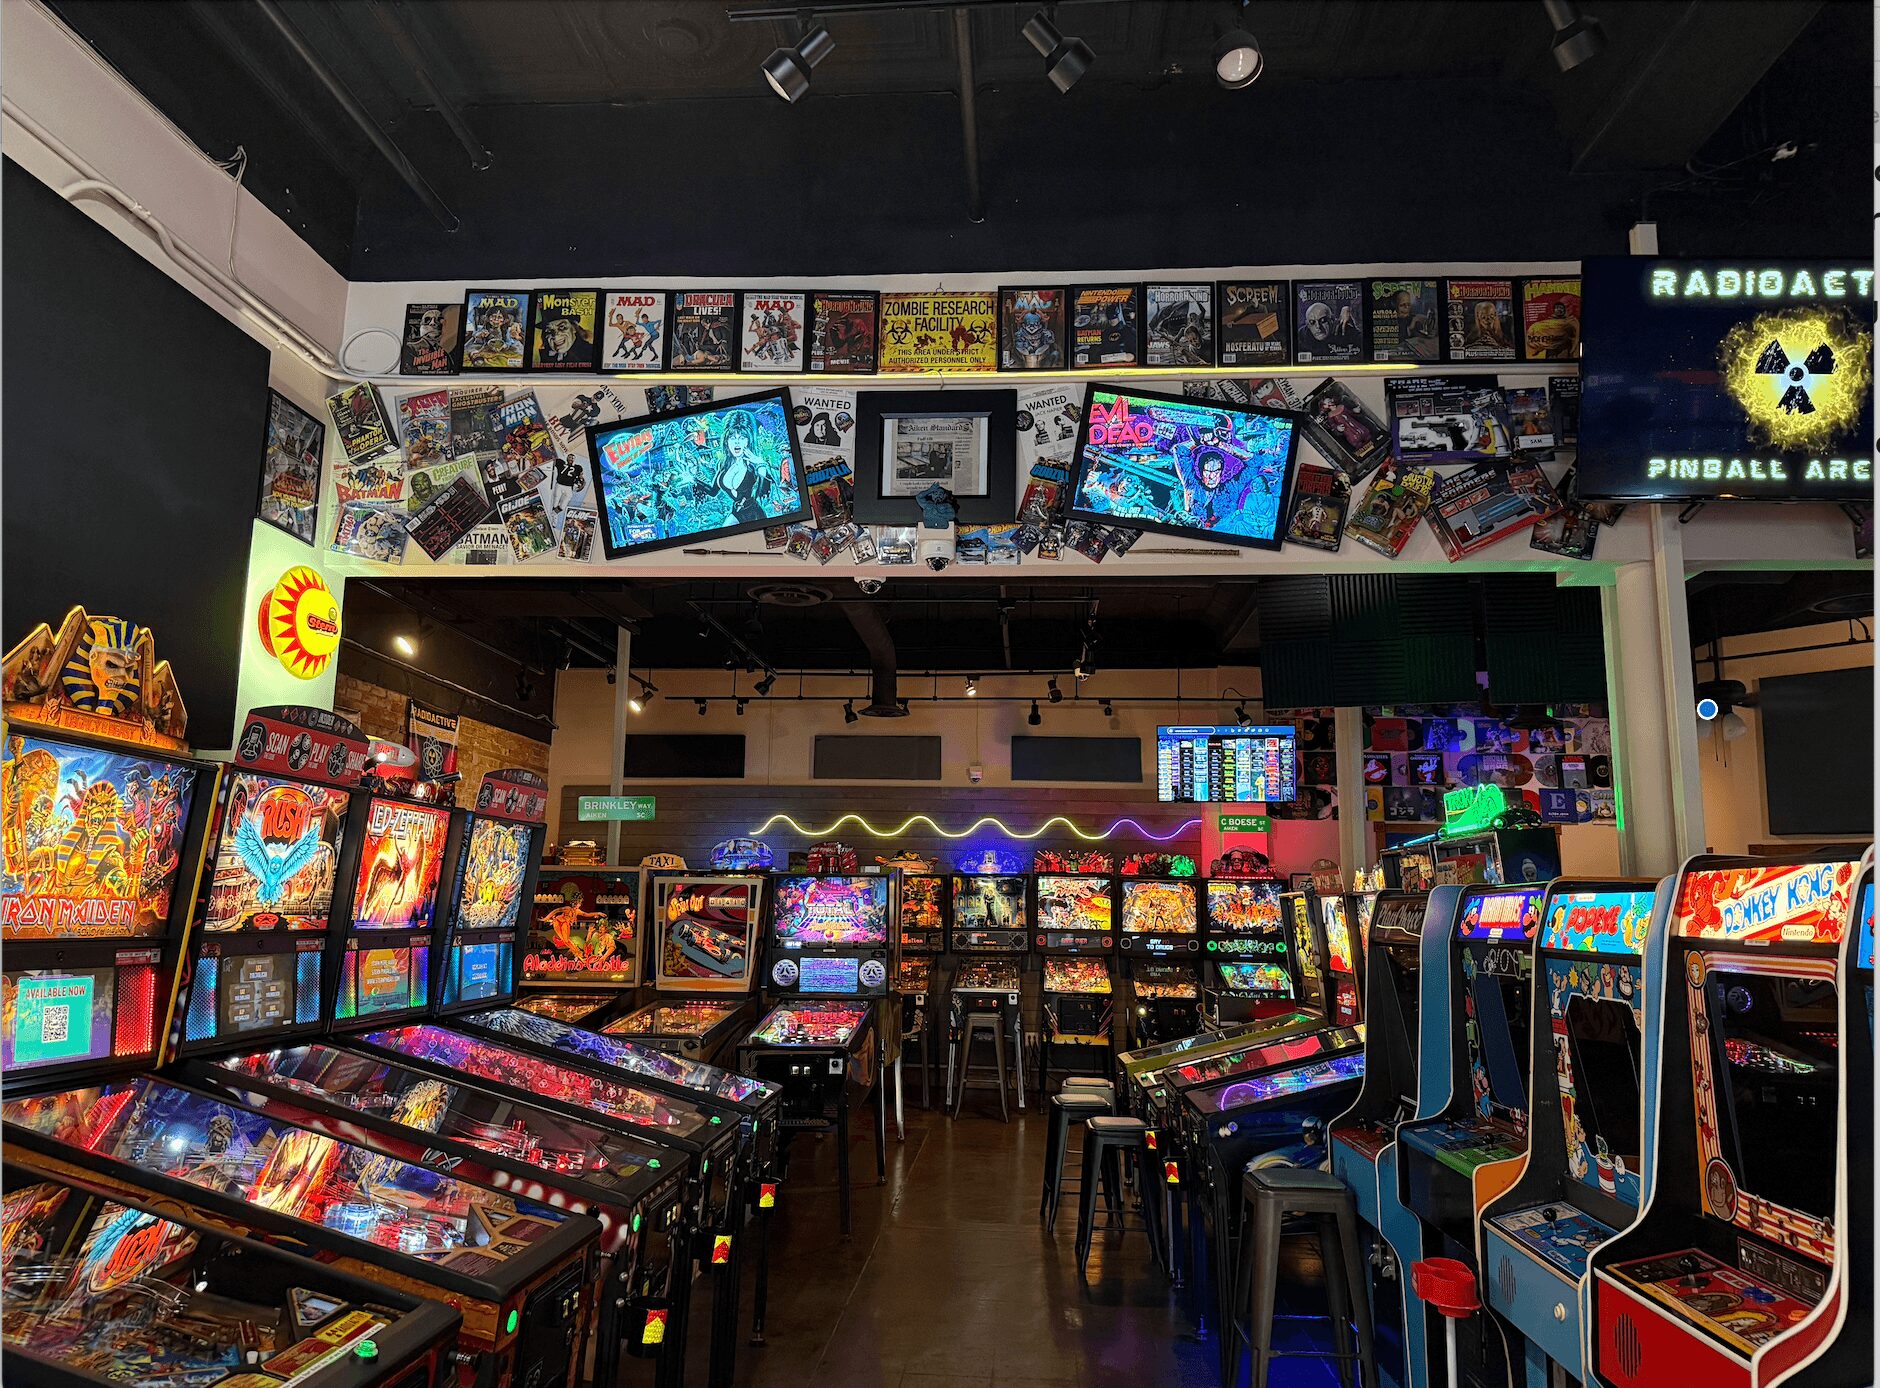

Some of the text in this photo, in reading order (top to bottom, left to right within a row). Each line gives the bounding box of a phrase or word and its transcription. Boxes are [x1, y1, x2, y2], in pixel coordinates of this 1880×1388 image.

[479, 298, 518, 308] MAD
[616, 297, 656, 306] MAD
[684, 293, 733, 307] DRACULA
[754, 301, 794, 311] MAD
[1095, 294, 1129, 303] POWER
[561, 308, 594, 316] BASH
[694, 306, 722, 316] LIVES!
[885, 300, 994, 316] ZOMBIE RESEARCH
[914, 317, 964, 332] FACILITY
[1147, 341, 1170, 349] JAWS
[1225, 342, 1264, 352] NOSFERATU
[413, 350, 445, 366] INVISIBLE
[432, 360, 448, 370] MAN
[500, 396, 536, 417] IRON
[611, 397, 626, 412] YOU
[804, 397, 851, 409] WANTED
[1025, 395, 1067, 411] WANTED
[1089, 396, 1136, 424] EVIL
[505, 406, 538, 426] MAN
[549, 415, 569, 437] BUY
[1089, 422, 1154, 445] DEAD
[360, 434, 385, 449] OPERA
[432, 458, 473, 481] CREATURE
[561, 463, 575, 476] 72
[806, 464, 852, 485] GODZILLA
[1647, 459, 1787, 480] PINBALL
[1402, 474, 1434, 486] AUSTIN
[336, 478, 405, 501] BATMAN
[308, 615, 338, 634] Stern
[413, 706, 458, 729] RADIOACTIVE
[266, 732, 289, 755] SCAN
[312, 743, 329, 764] PLAY
[584, 801, 637, 810] BRINKLEY
[1550, 793, 1566, 810] E
[261, 800, 311, 840] RUSH
[649, 856, 675, 867] TAXI
[1723, 863, 1834, 936] DONKEY KONG
[2, 898, 136, 934] IRON MAIDEN
[1565, 905, 1621, 935] POPEYE
[1782, 927, 1814, 937] Nintendo
[523, 954, 629, 972] Aladdin's Castle
[25, 986, 86, 999] AVAILABLE NOW
